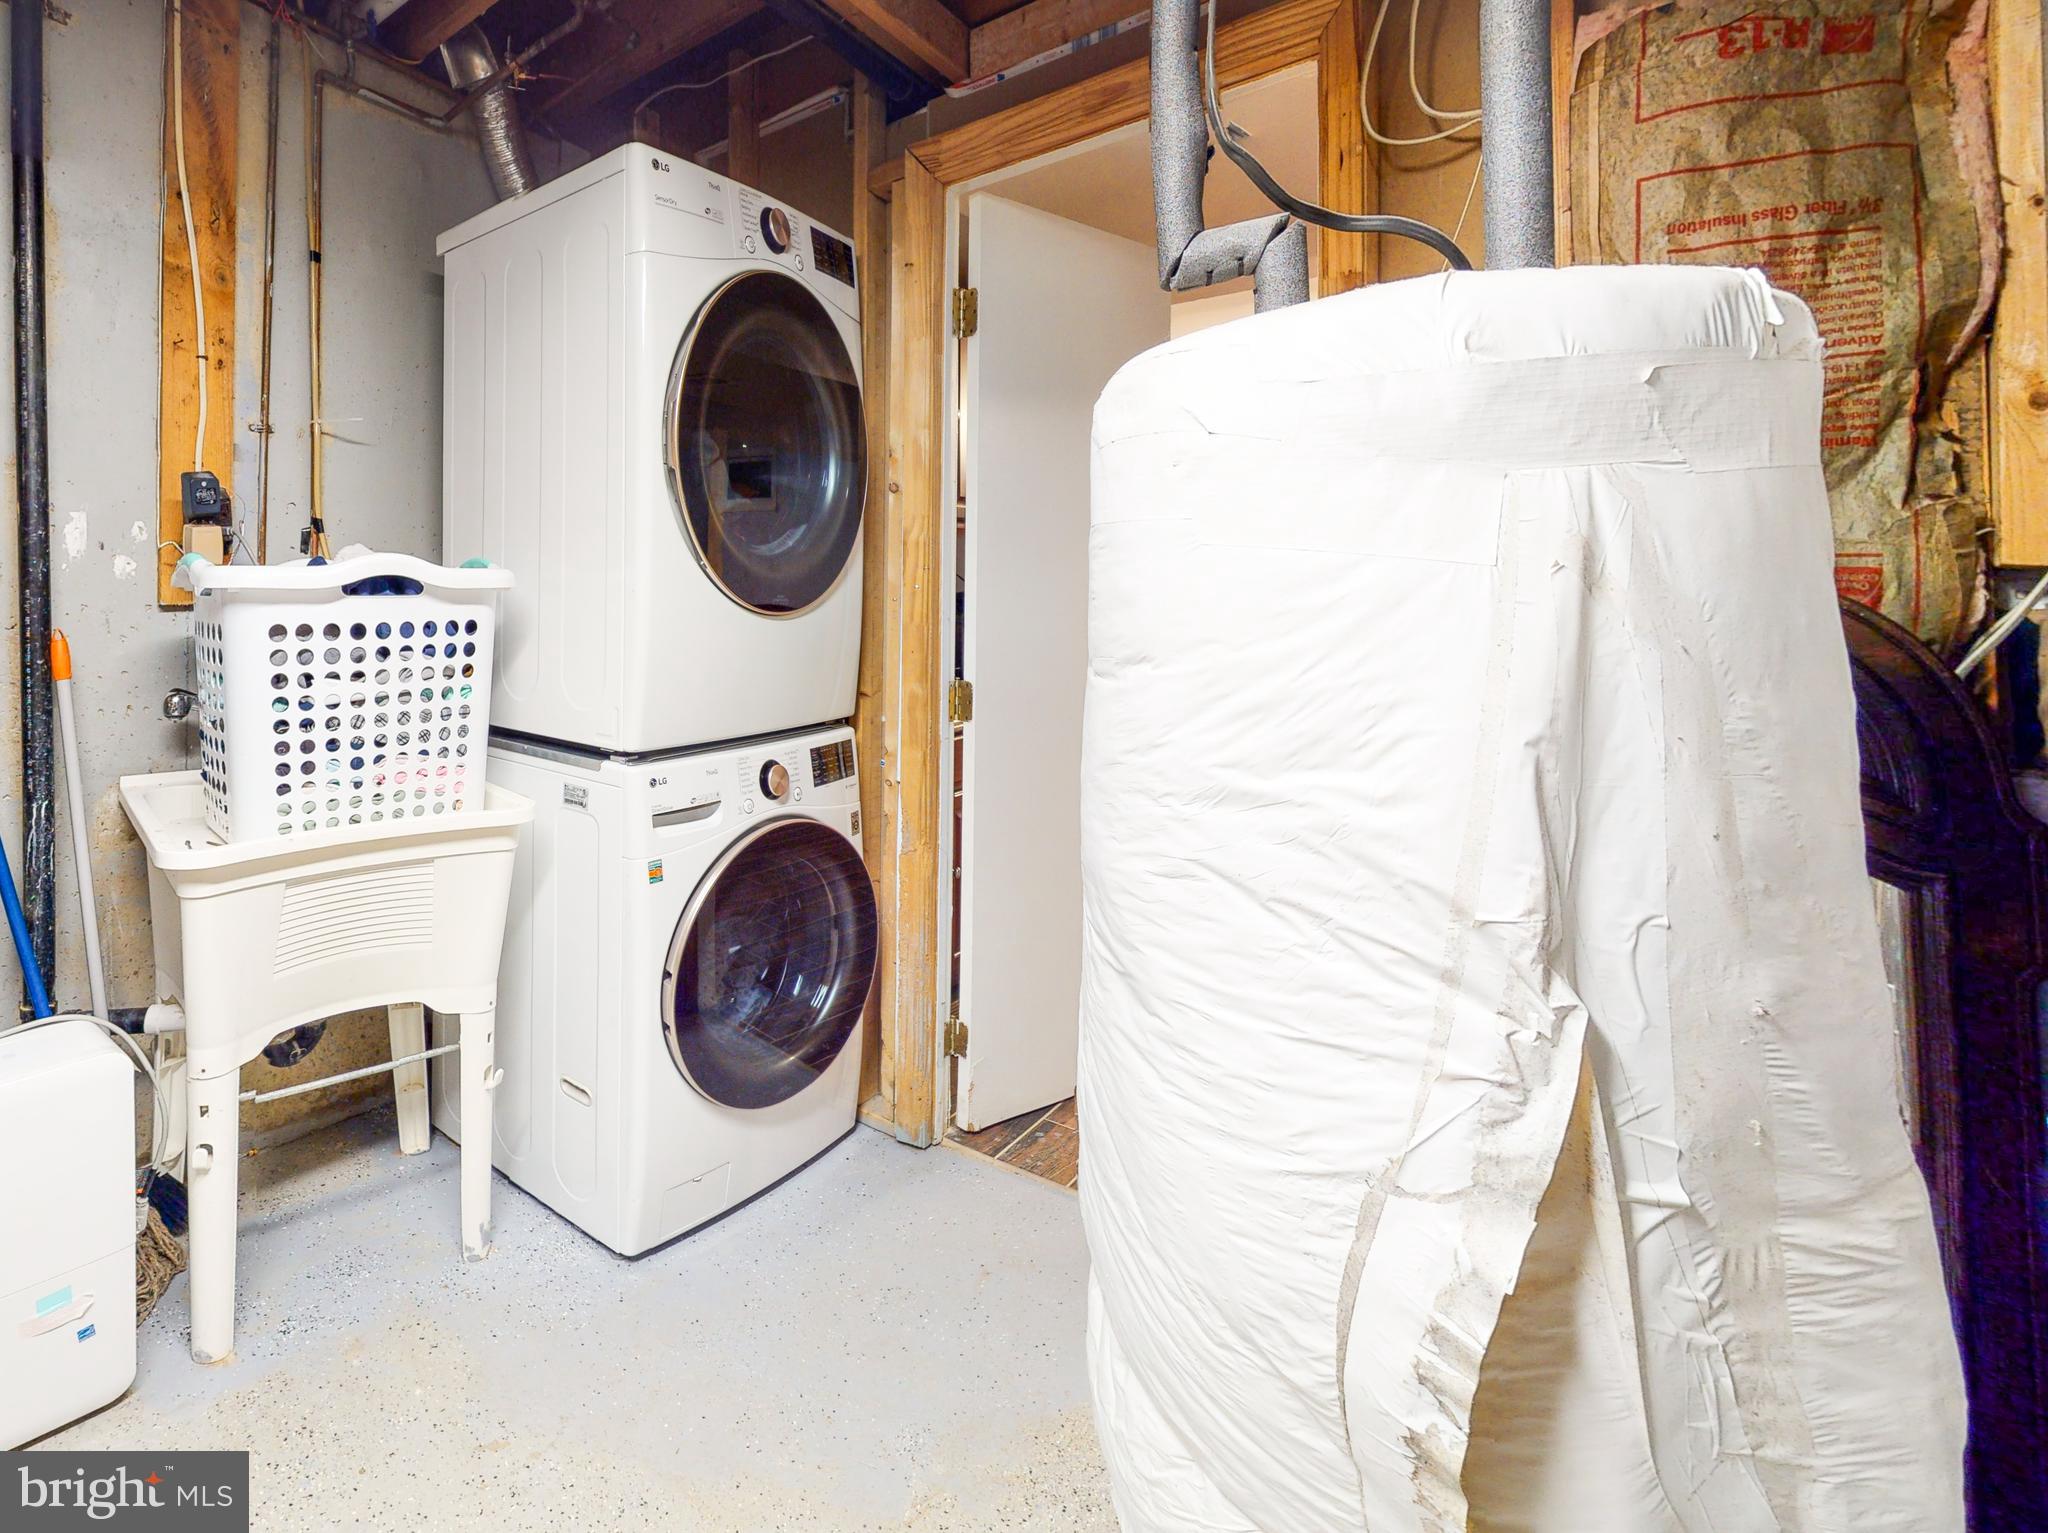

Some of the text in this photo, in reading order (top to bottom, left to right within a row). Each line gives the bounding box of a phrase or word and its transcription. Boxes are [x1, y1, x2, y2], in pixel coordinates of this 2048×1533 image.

[1751, 202, 1798, 221] Glass
[1803, 200, 1847, 215] Fiber
[1666, 214, 1747, 235] Insulation
